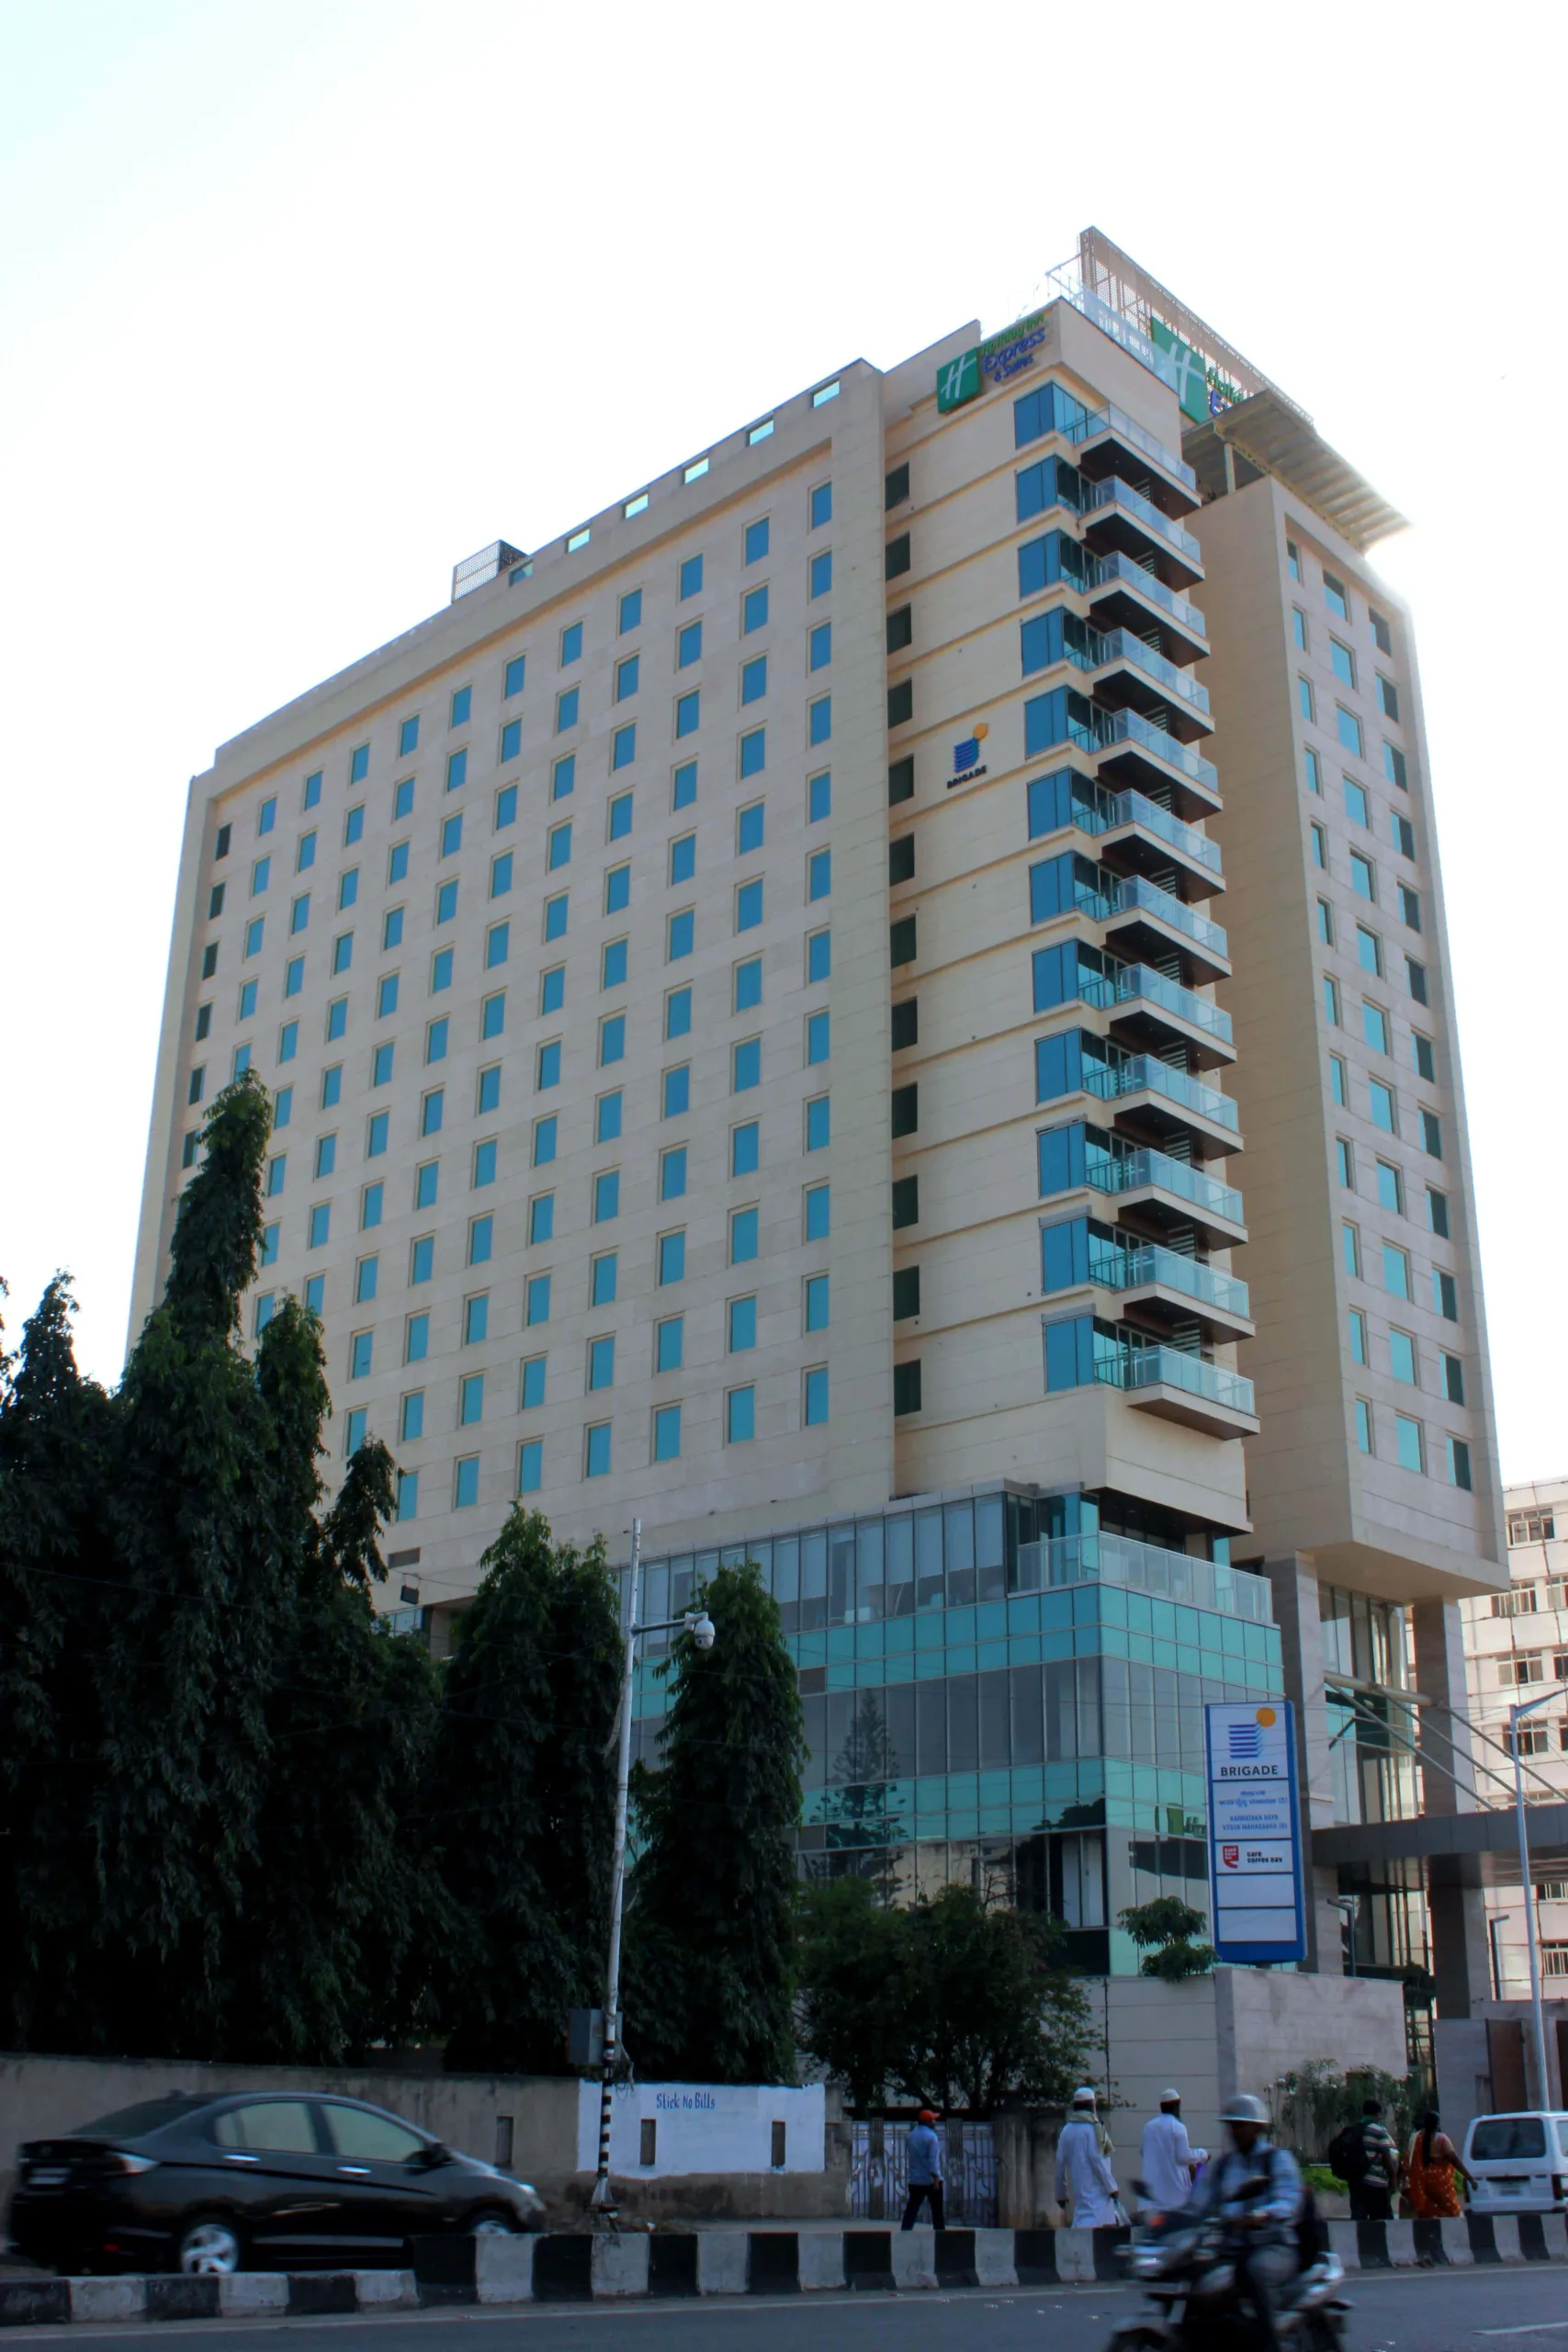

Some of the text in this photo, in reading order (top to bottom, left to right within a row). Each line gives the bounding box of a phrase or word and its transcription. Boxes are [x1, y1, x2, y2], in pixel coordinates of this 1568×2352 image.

[982, 313, 1044, 355] Holiday Inn
[983, 326, 1045, 374] Express
[946, 764, 987, 789] BRIGADE
[1220, 1765, 1279, 1776] BRIGADE
[656, 2091, 716, 2110] Stick No Bills
